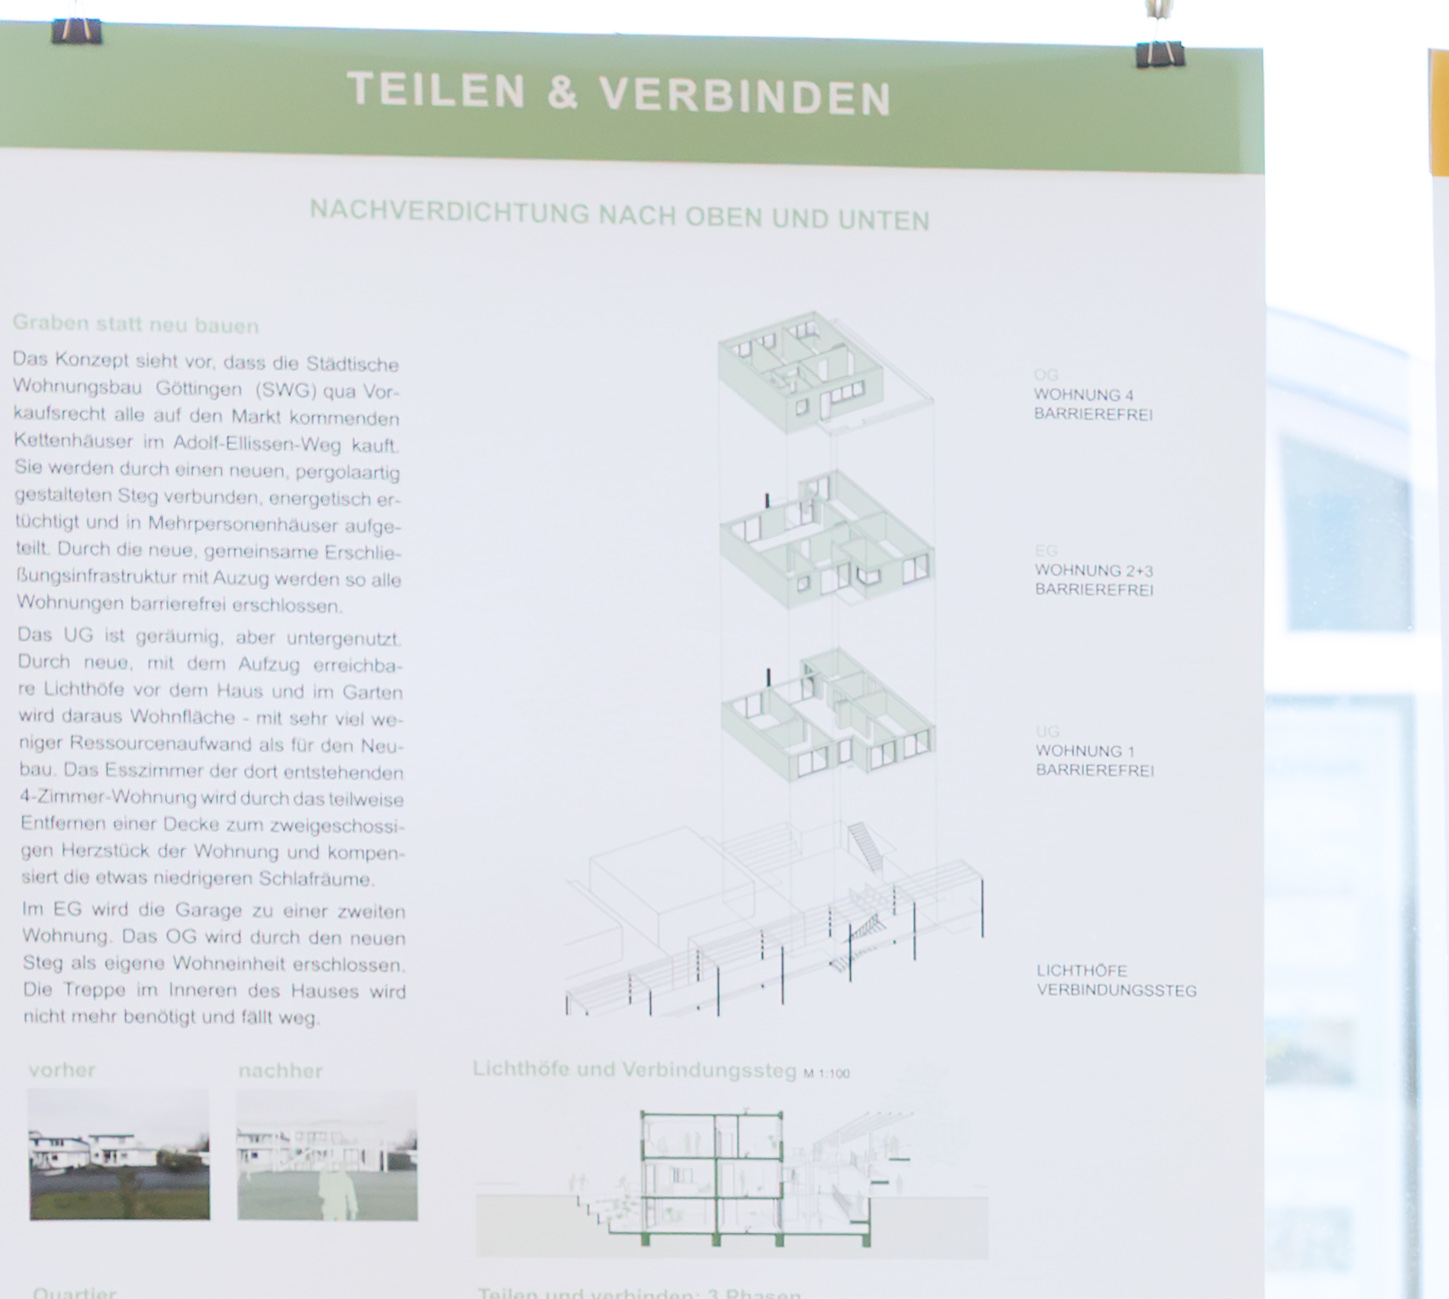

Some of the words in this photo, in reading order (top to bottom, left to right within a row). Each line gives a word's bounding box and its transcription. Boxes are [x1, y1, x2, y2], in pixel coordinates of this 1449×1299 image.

[346, 70, 526, 110] TEILEN
[547, 74, 579, 112] &
[598, 76, 892, 118] VERBINDEN
[310, 197, 589, 224] NACHVERDICHTUNG
[599, 203, 675, 226] NACH
[685, 205, 762, 227] OBEN
[772, 207, 829, 229] UND
[838, 208, 929, 231] UNTEN
[11, 312, 89, 331] Graben
[96, 315, 142, 332] statt
[149, 319, 187, 333] neu
[194, 315, 259, 334] bauen
[12, 349, 48, 366] Das
[55, 350, 129, 370] Konzept
[135, 352, 177, 369] sieht
[184, 356, 215, 370] vor,
[223, 354, 266, 370] dass
[272, 355, 299, 371] die
[306, 355, 399, 373] Städtische
[11, 376, 142, 398] Wohnungsbau
[155, 379, 242, 400] Göttingen
[255, 381, 317, 400] (SWG)
[322, 386, 356, 401] qua
[362, 382, 399, 400] Vor-
[1033, 387, 1121, 402] WOHNUNG
[1124, 388, 1133, 401] 4
[1034, 406, 1152, 421] BARRIEREFREI
[1034, 563, 1121, 577] WOHNUNG
[1125, 564, 1153, 578] 2+3
[1035, 581, 1153, 596] BARRIEREFREI
[1035, 743, 1122, 758] WOHNUNG
[1035, 761, 1154, 777] BARRIEREFREI
[1036, 962, 1127, 977] LICHTHÖFE
[1036, 981, 1197, 1000] VERBINDUNGSSTEG
[27, 1061, 95, 1078] vorher
[237, 1061, 323, 1079] nachher
[472, 1059, 570, 1077] Lichthöfe
[576, 1060, 616, 1077] und
[621, 1060, 797, 1082] Verbindungssteg
[803, 1067, 814, 1079] M
[819, 1067, 852, 1080] 1:100
